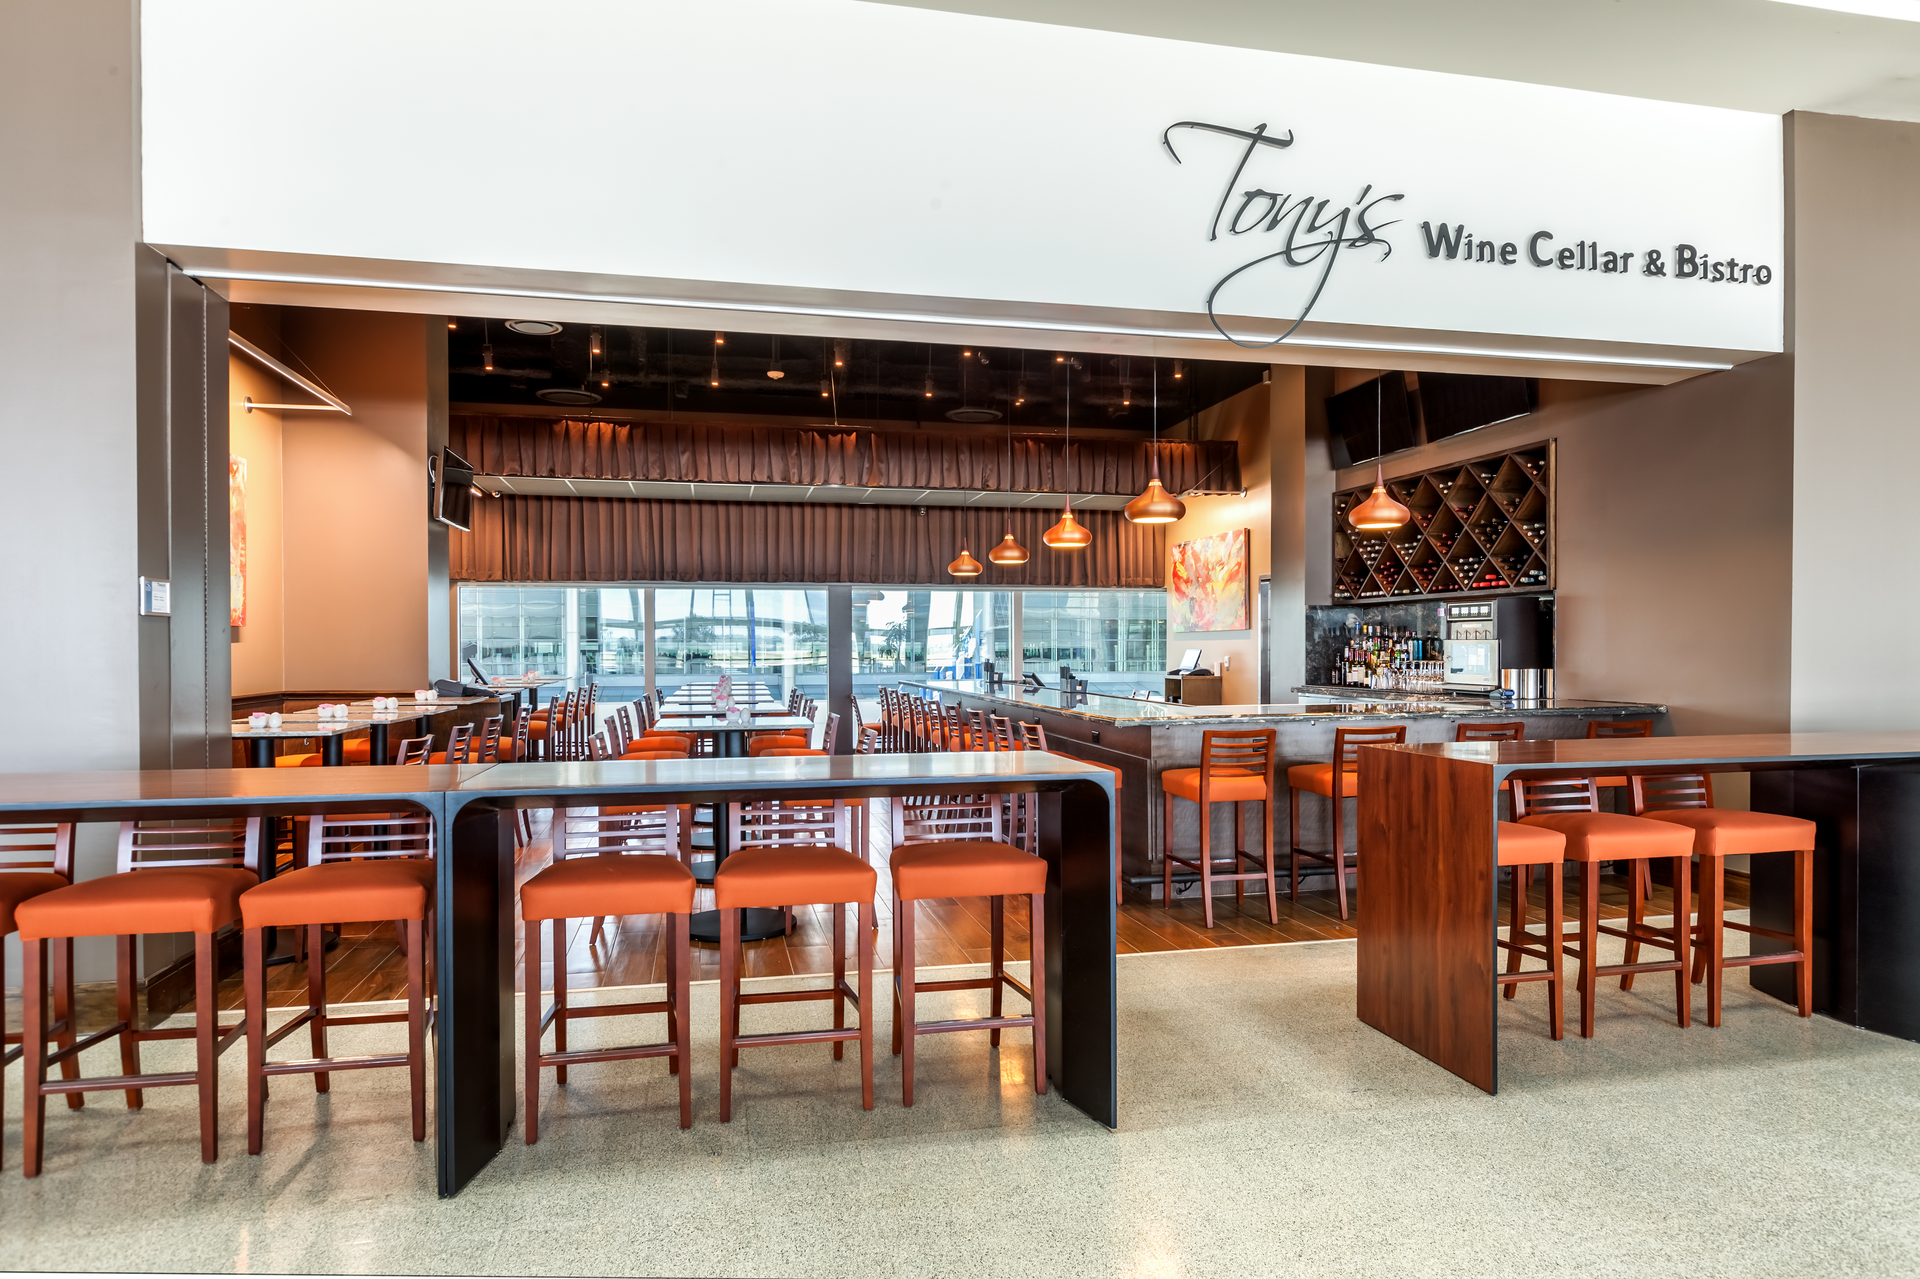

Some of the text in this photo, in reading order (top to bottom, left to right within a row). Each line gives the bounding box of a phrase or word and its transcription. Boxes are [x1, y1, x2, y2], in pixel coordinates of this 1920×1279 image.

[1163, 121, 1405, 349] Tony's
[1420, 220, 1773, 286] Wine Cellar & Bistro
